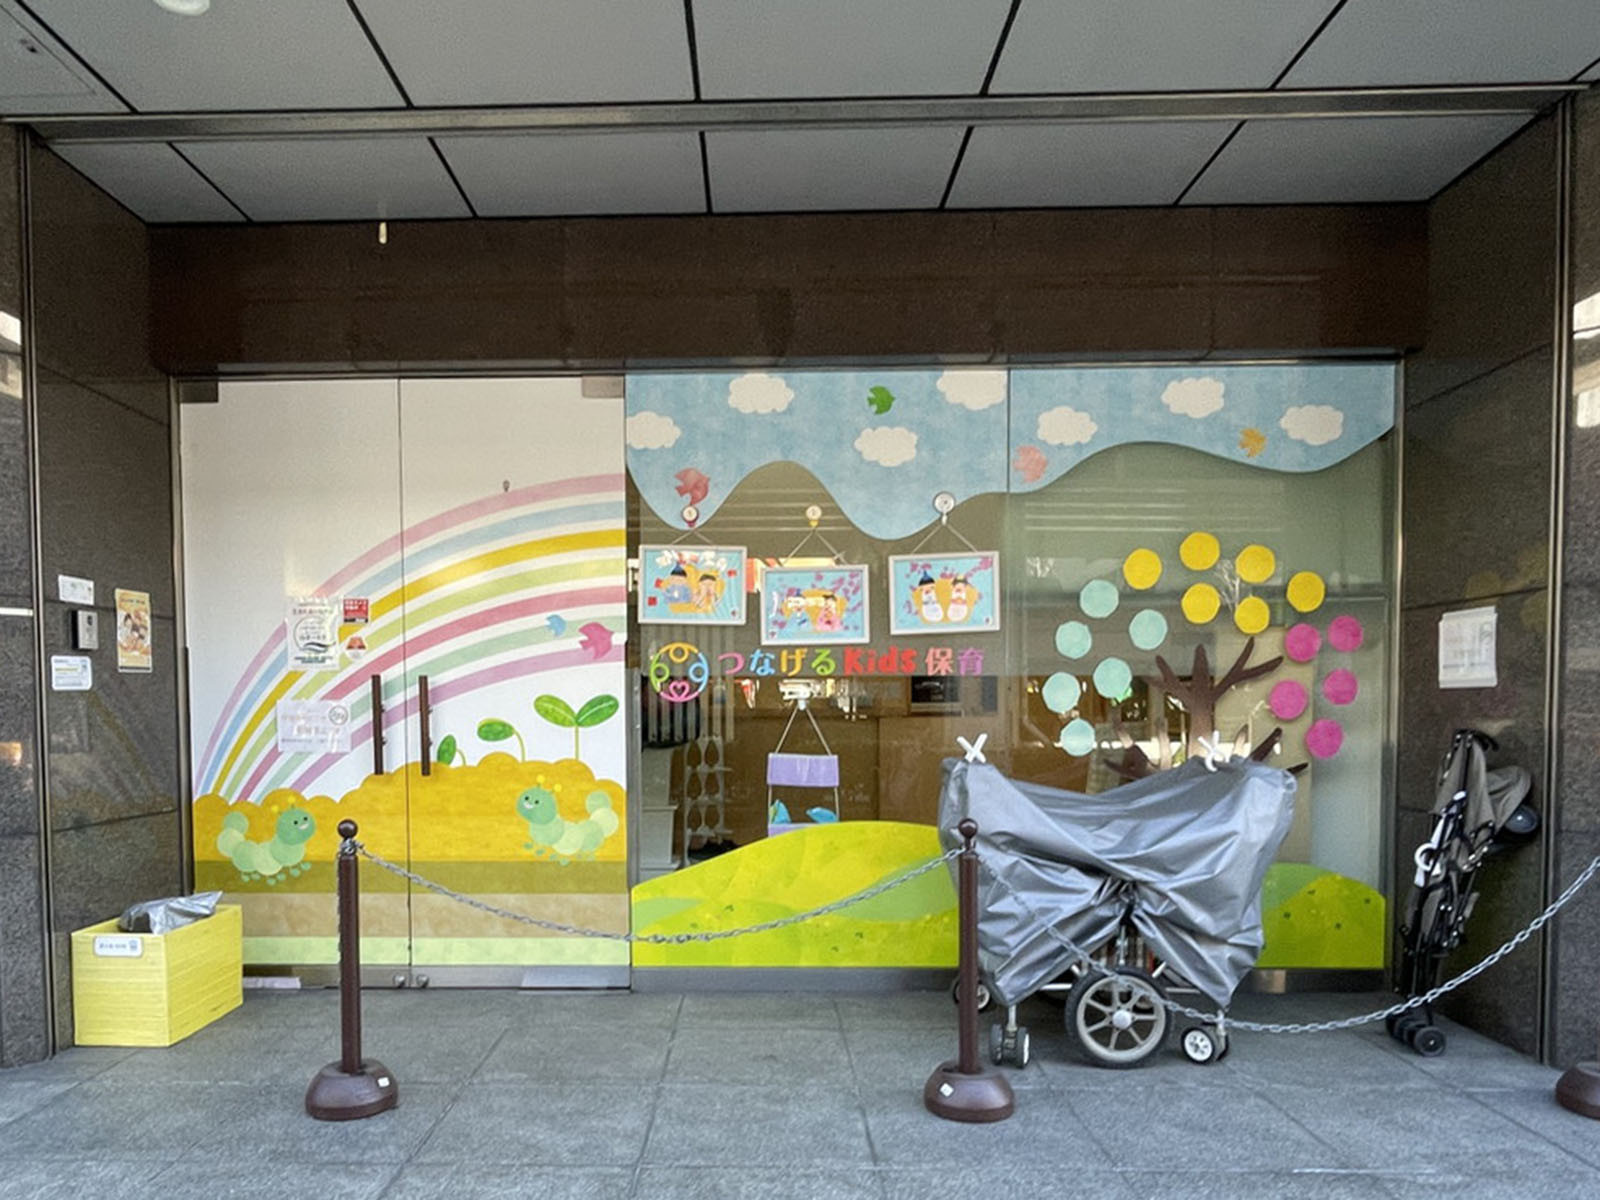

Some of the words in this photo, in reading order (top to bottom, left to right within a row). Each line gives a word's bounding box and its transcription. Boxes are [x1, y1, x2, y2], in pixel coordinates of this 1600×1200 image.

[718, 646, 984, 676] つなげるKids保育
